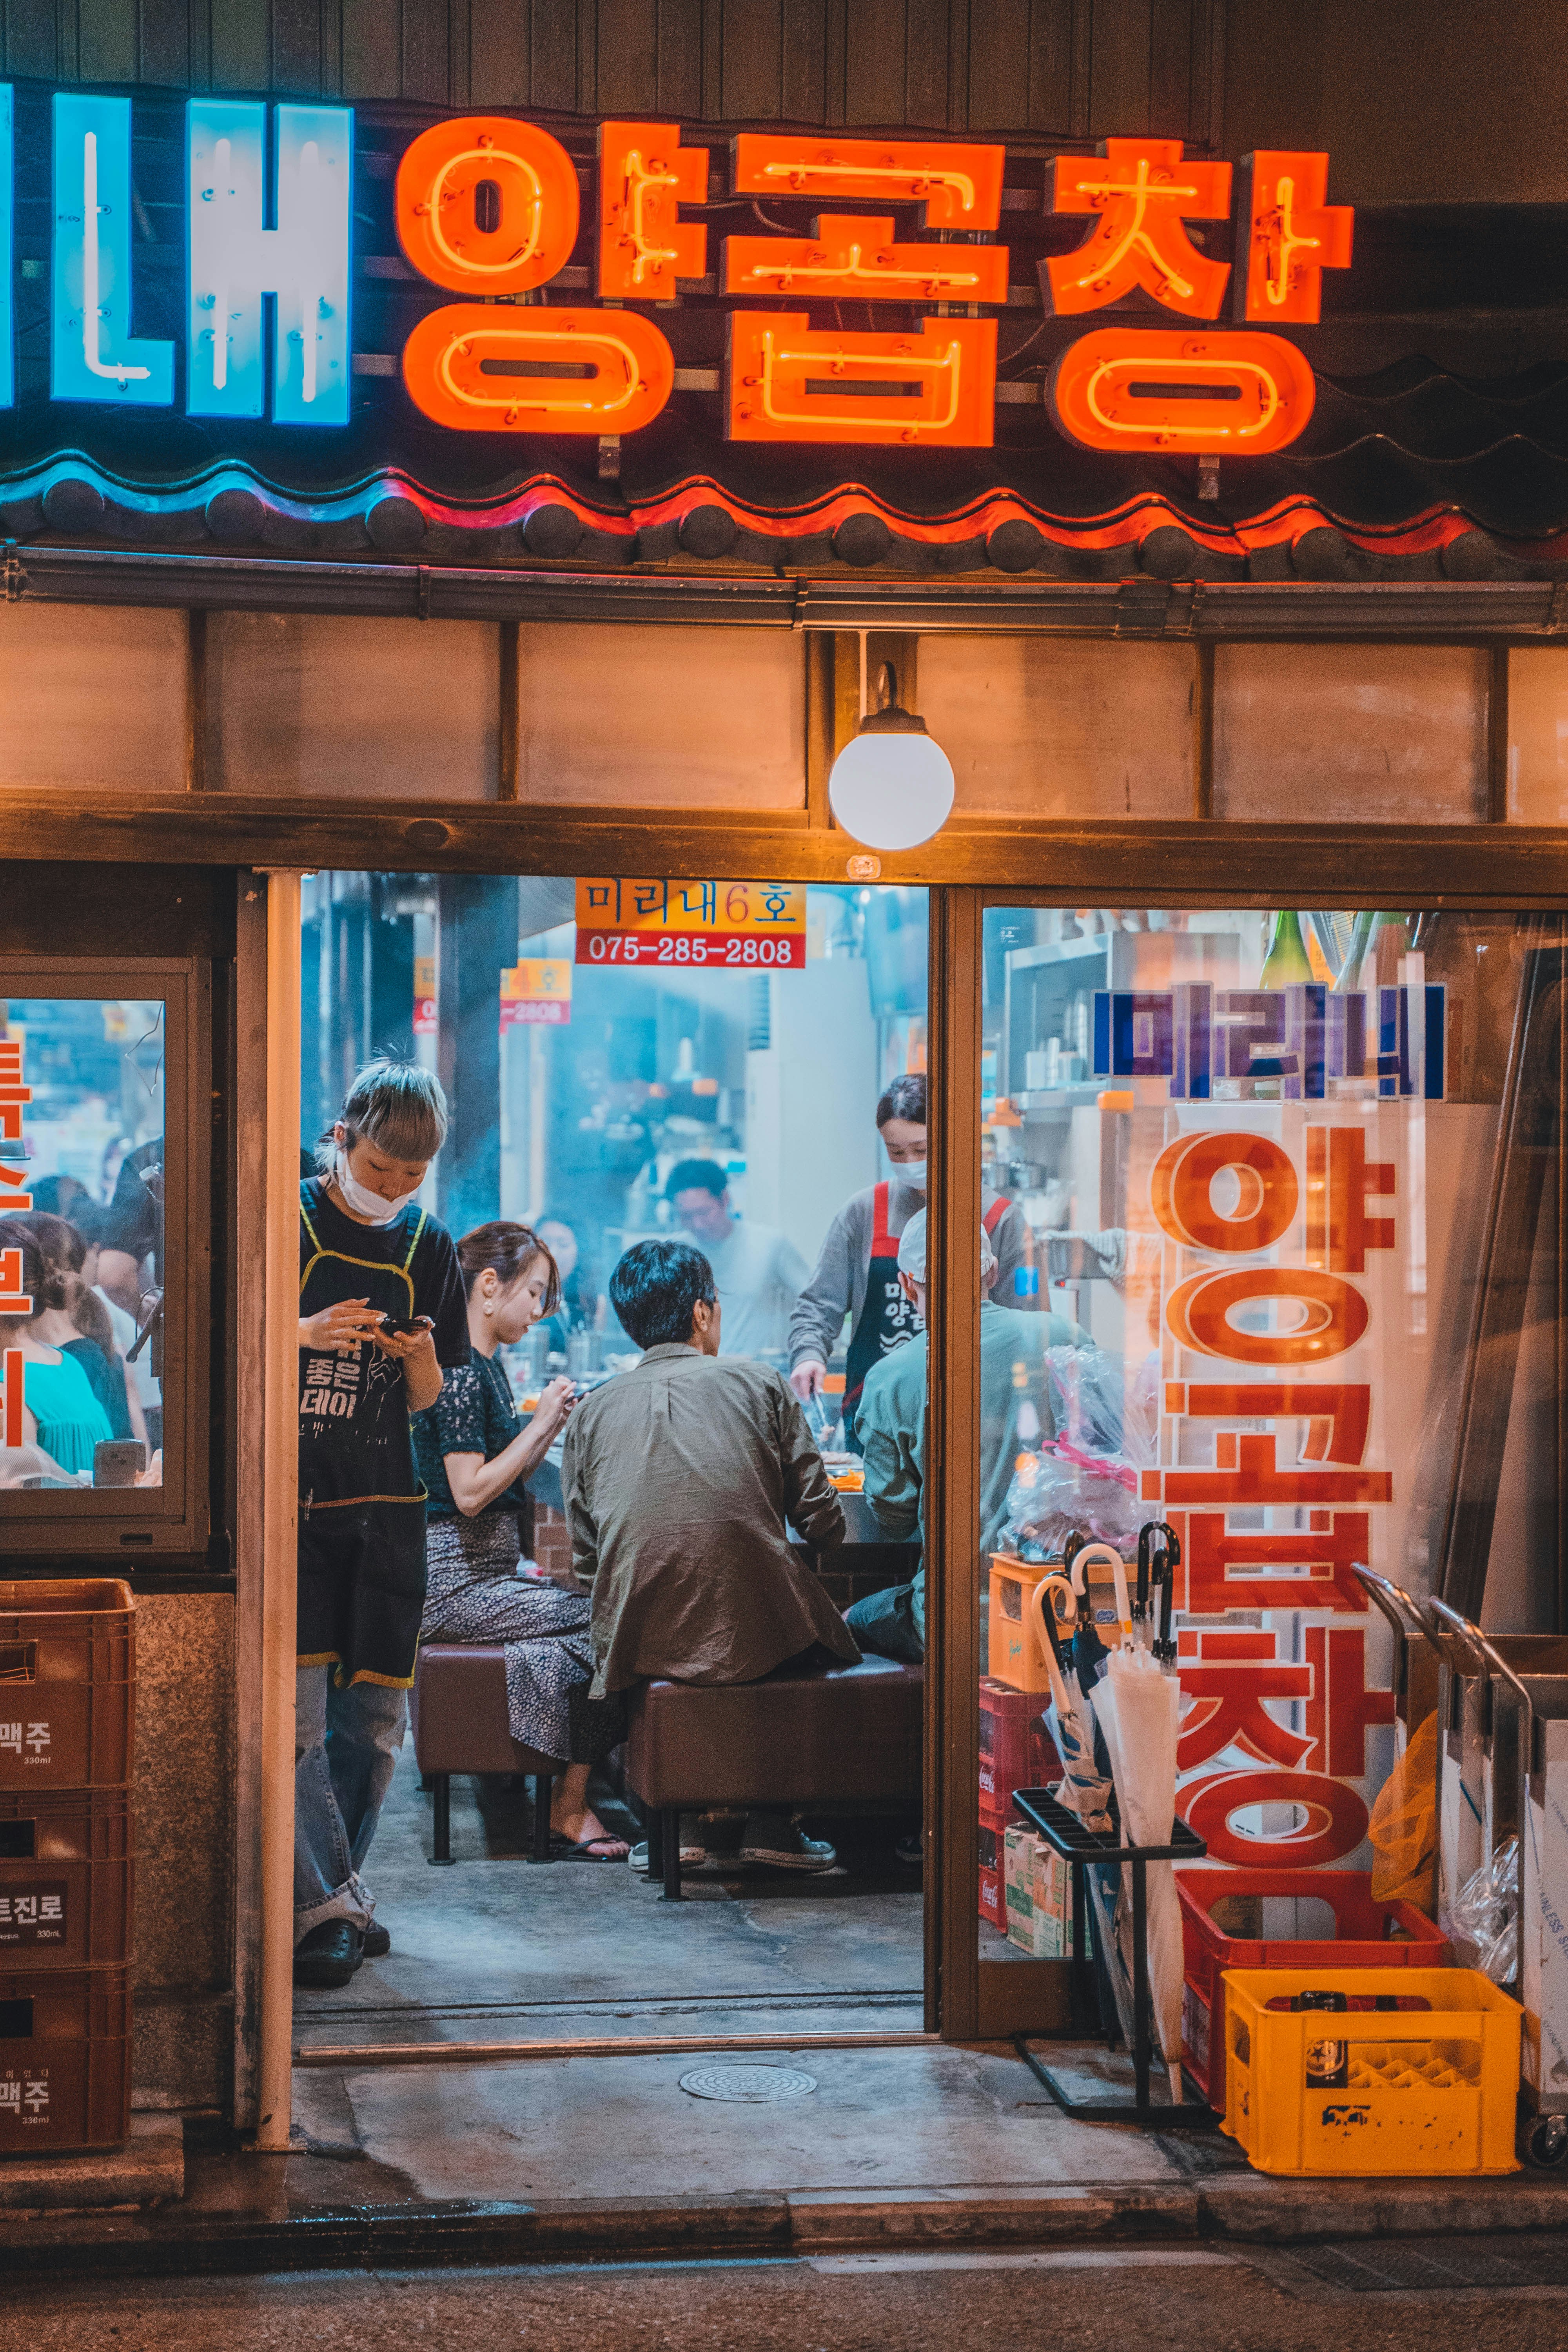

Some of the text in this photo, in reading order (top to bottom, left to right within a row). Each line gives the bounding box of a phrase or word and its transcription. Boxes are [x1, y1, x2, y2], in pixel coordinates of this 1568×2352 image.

[0, 83, 1355, 455] 내 양곱창
[589, 936, 792, 963] 075-285-2808
[1090, 982, 1448, 1101] 미리내
[300, 1388, 356, 1419] 데이
[0, 1722, 51, 1754] 맥주
[0, 2082, 49, 2113] 맥주
